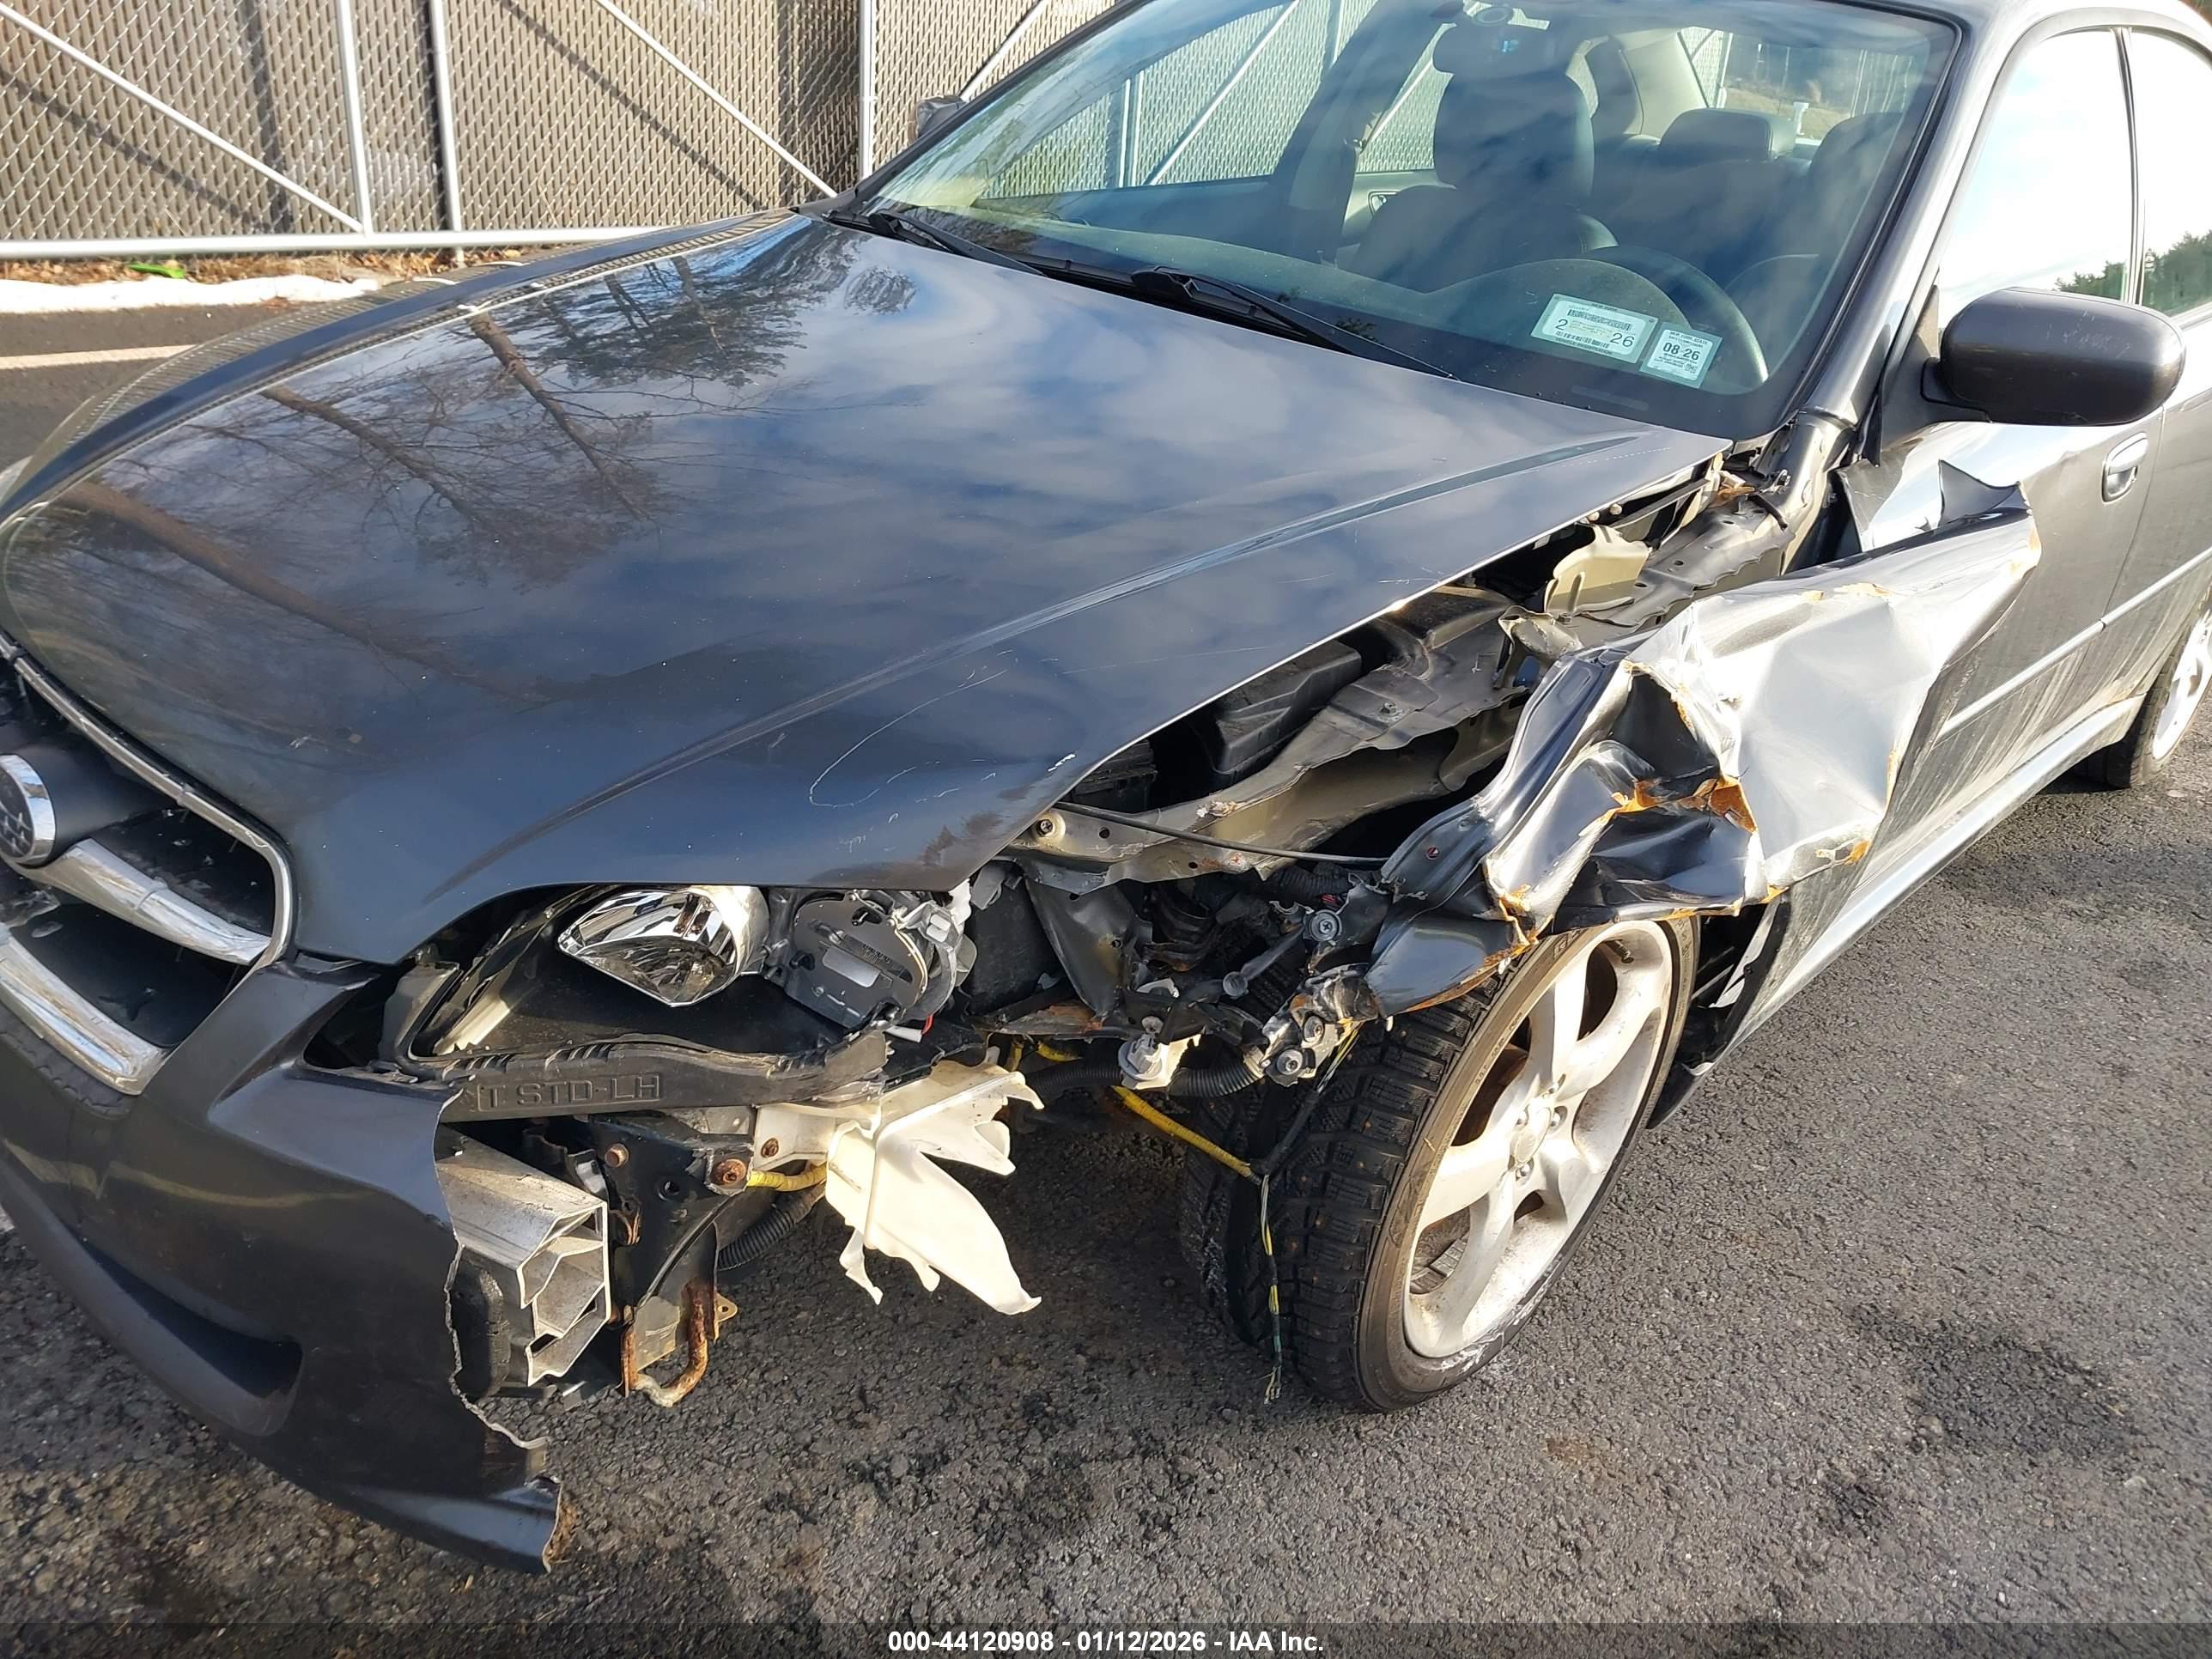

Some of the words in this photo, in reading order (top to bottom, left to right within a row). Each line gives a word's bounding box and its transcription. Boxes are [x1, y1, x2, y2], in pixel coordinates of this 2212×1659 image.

[1555, 319, 1568, 331] 2
[1610, 332, 1635, 348] 26
[1663, 342, 1680, 355] 08
[1683, 347, 1700, 361] 26
[517, 1075, 660, 1106] STD-LH
